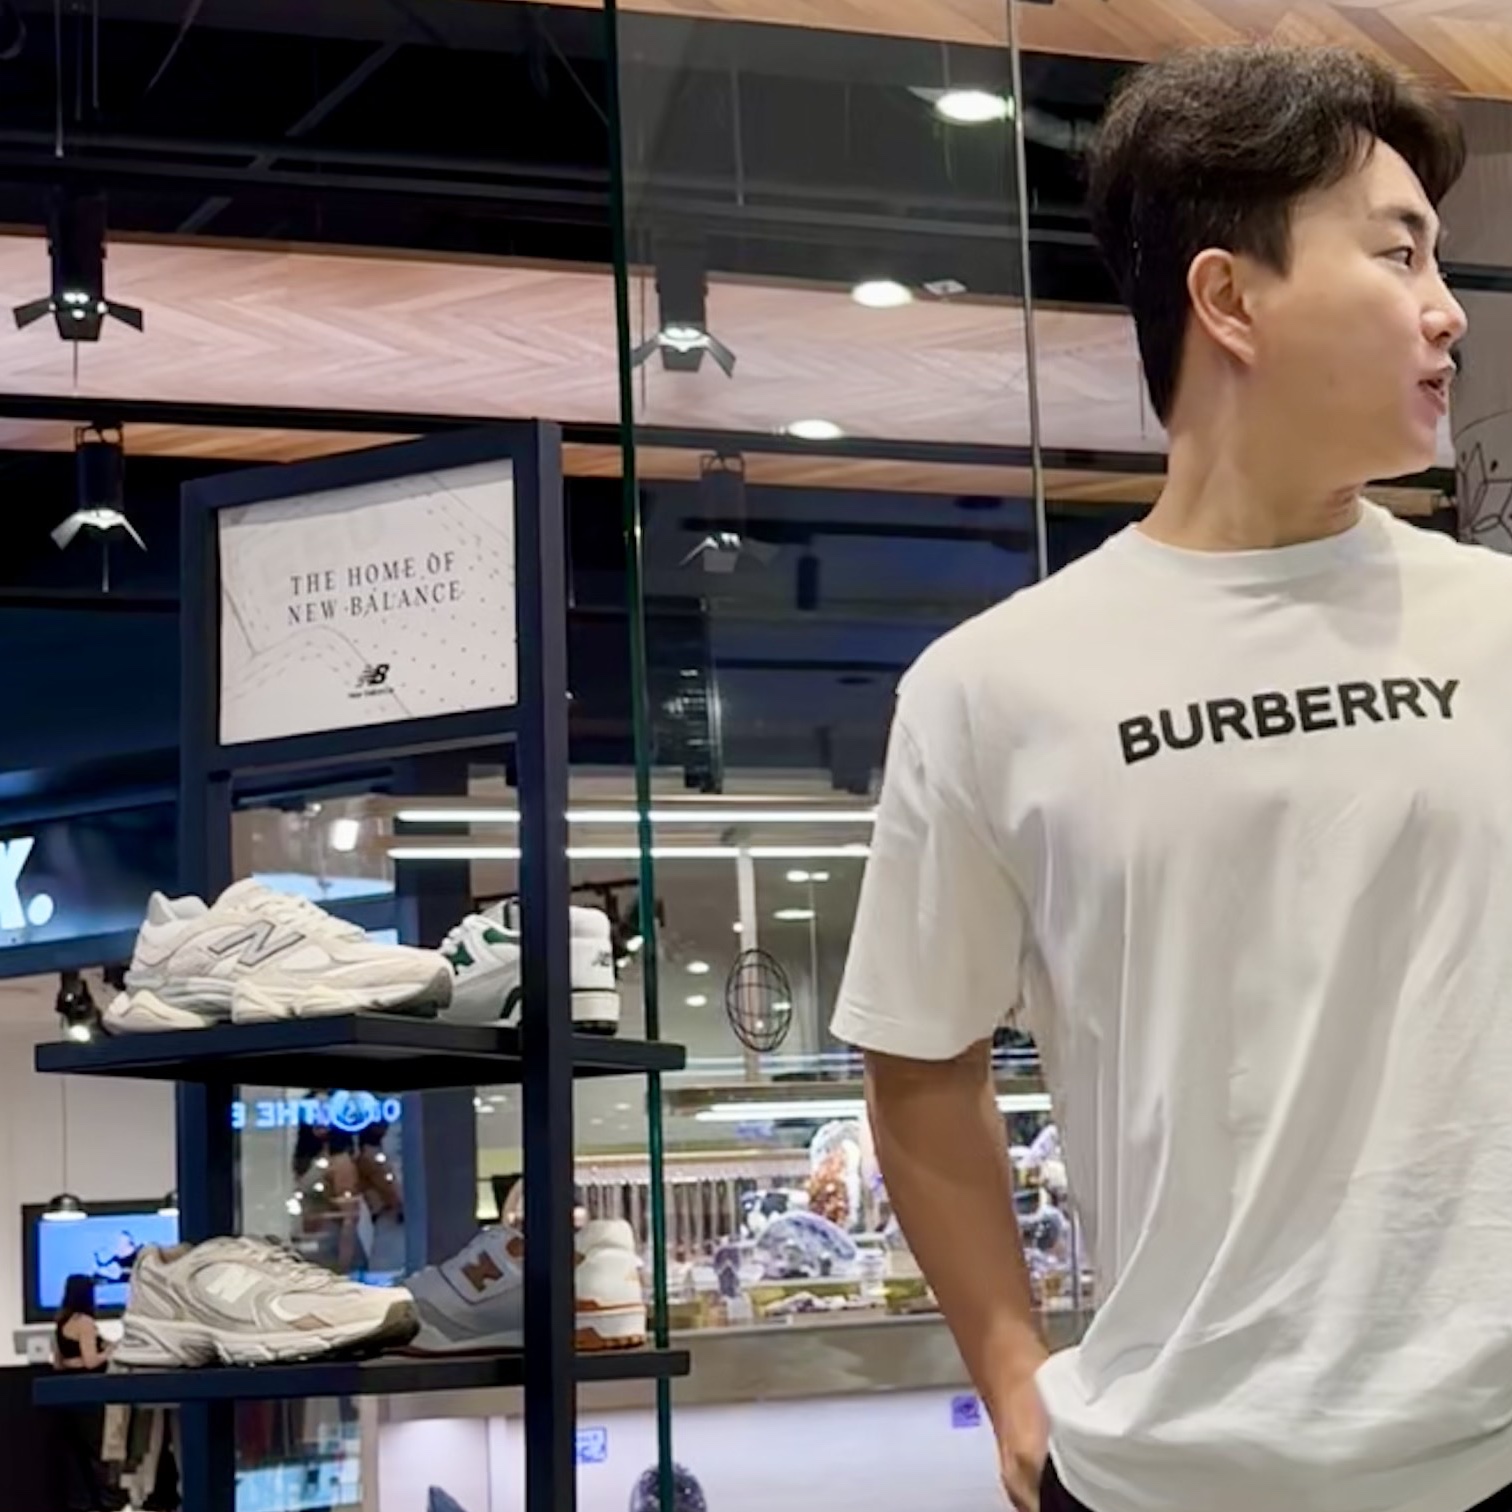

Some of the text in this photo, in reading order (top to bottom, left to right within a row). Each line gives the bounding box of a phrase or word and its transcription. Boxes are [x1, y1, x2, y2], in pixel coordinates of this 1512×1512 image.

[290, 551, 456, 597] THE HOME OF
[287, 580, 462, 626] NEW BALANCE
[1118, 676, 1460, 765] BURBERRY
